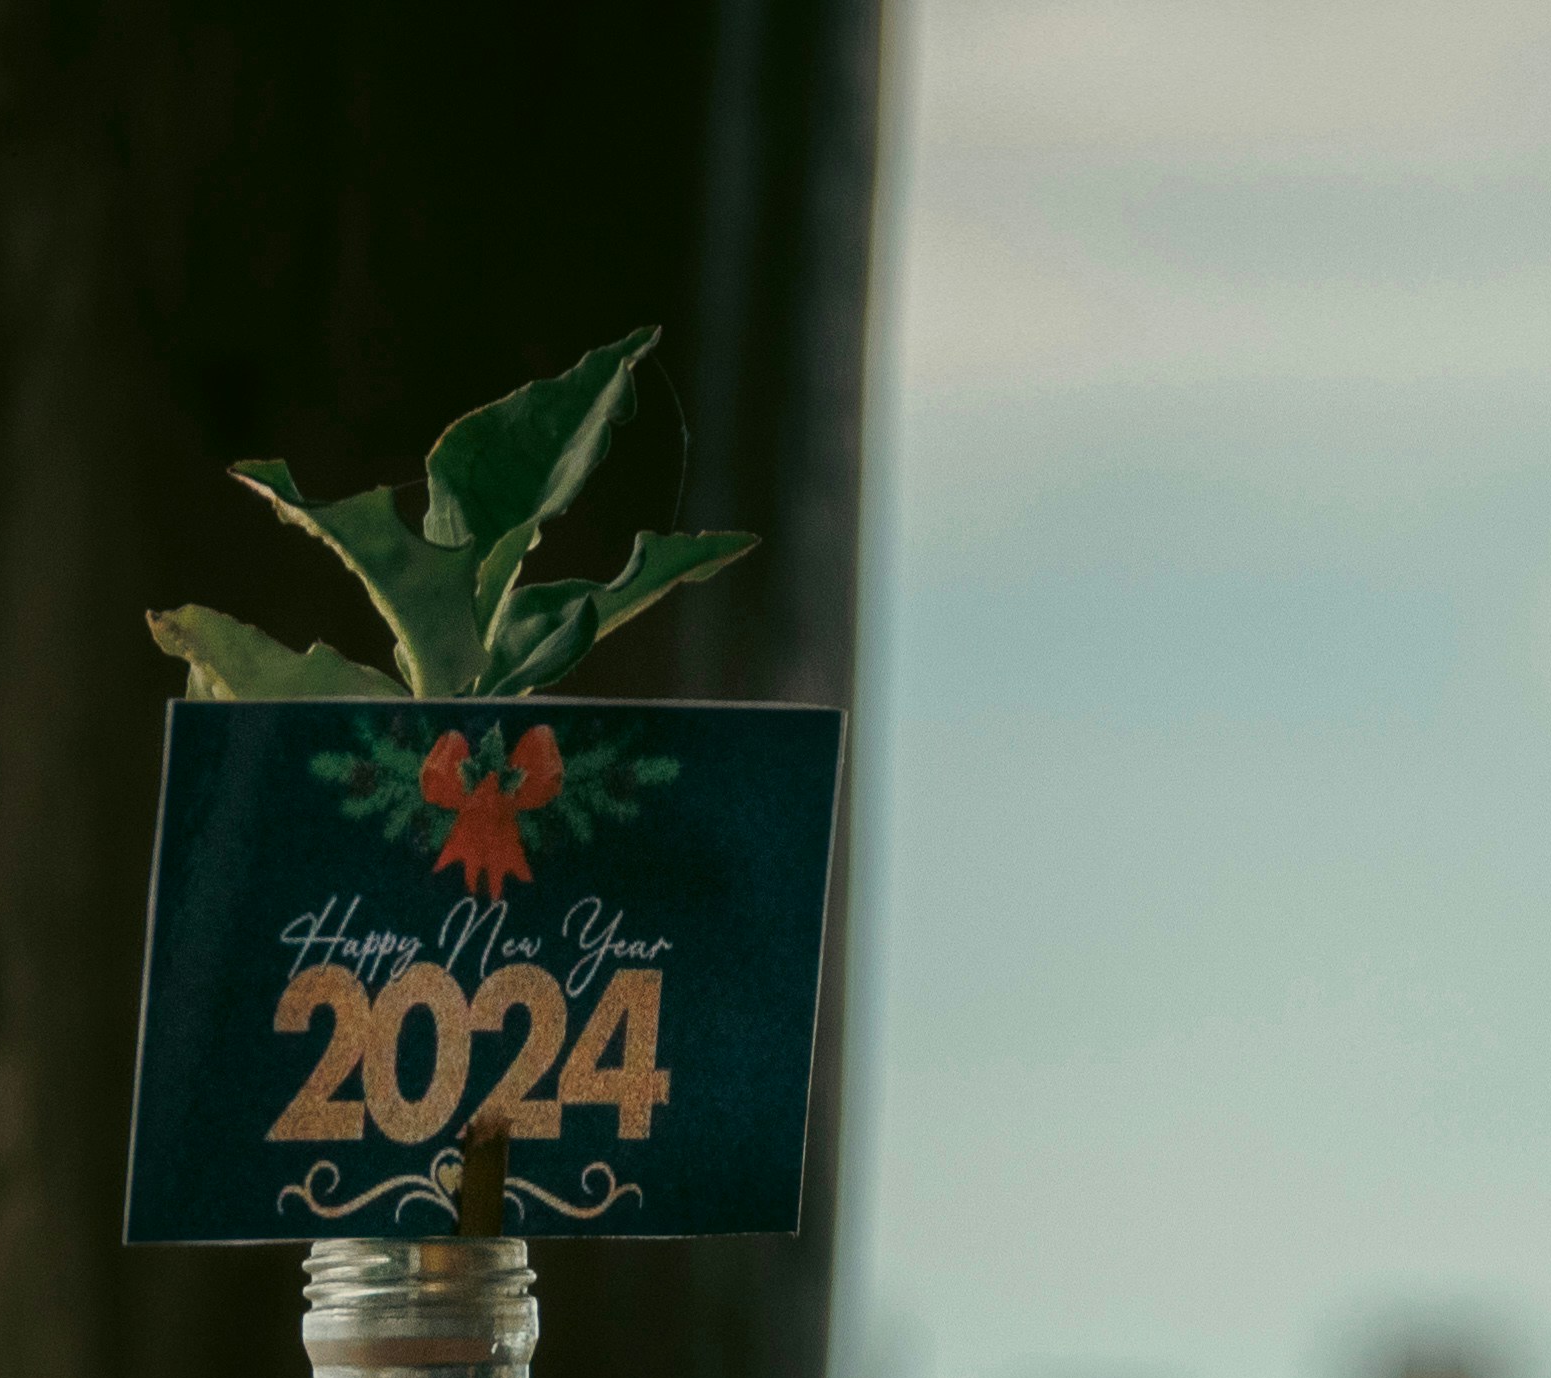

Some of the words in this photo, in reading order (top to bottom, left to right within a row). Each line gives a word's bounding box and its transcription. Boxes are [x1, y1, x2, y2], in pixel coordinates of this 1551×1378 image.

[281, 895, 423, 982] Happy
[438, 897, 541, 980] New
[562, 897, 673, 998] Year
[265, 961, 671, 1145] 2024
